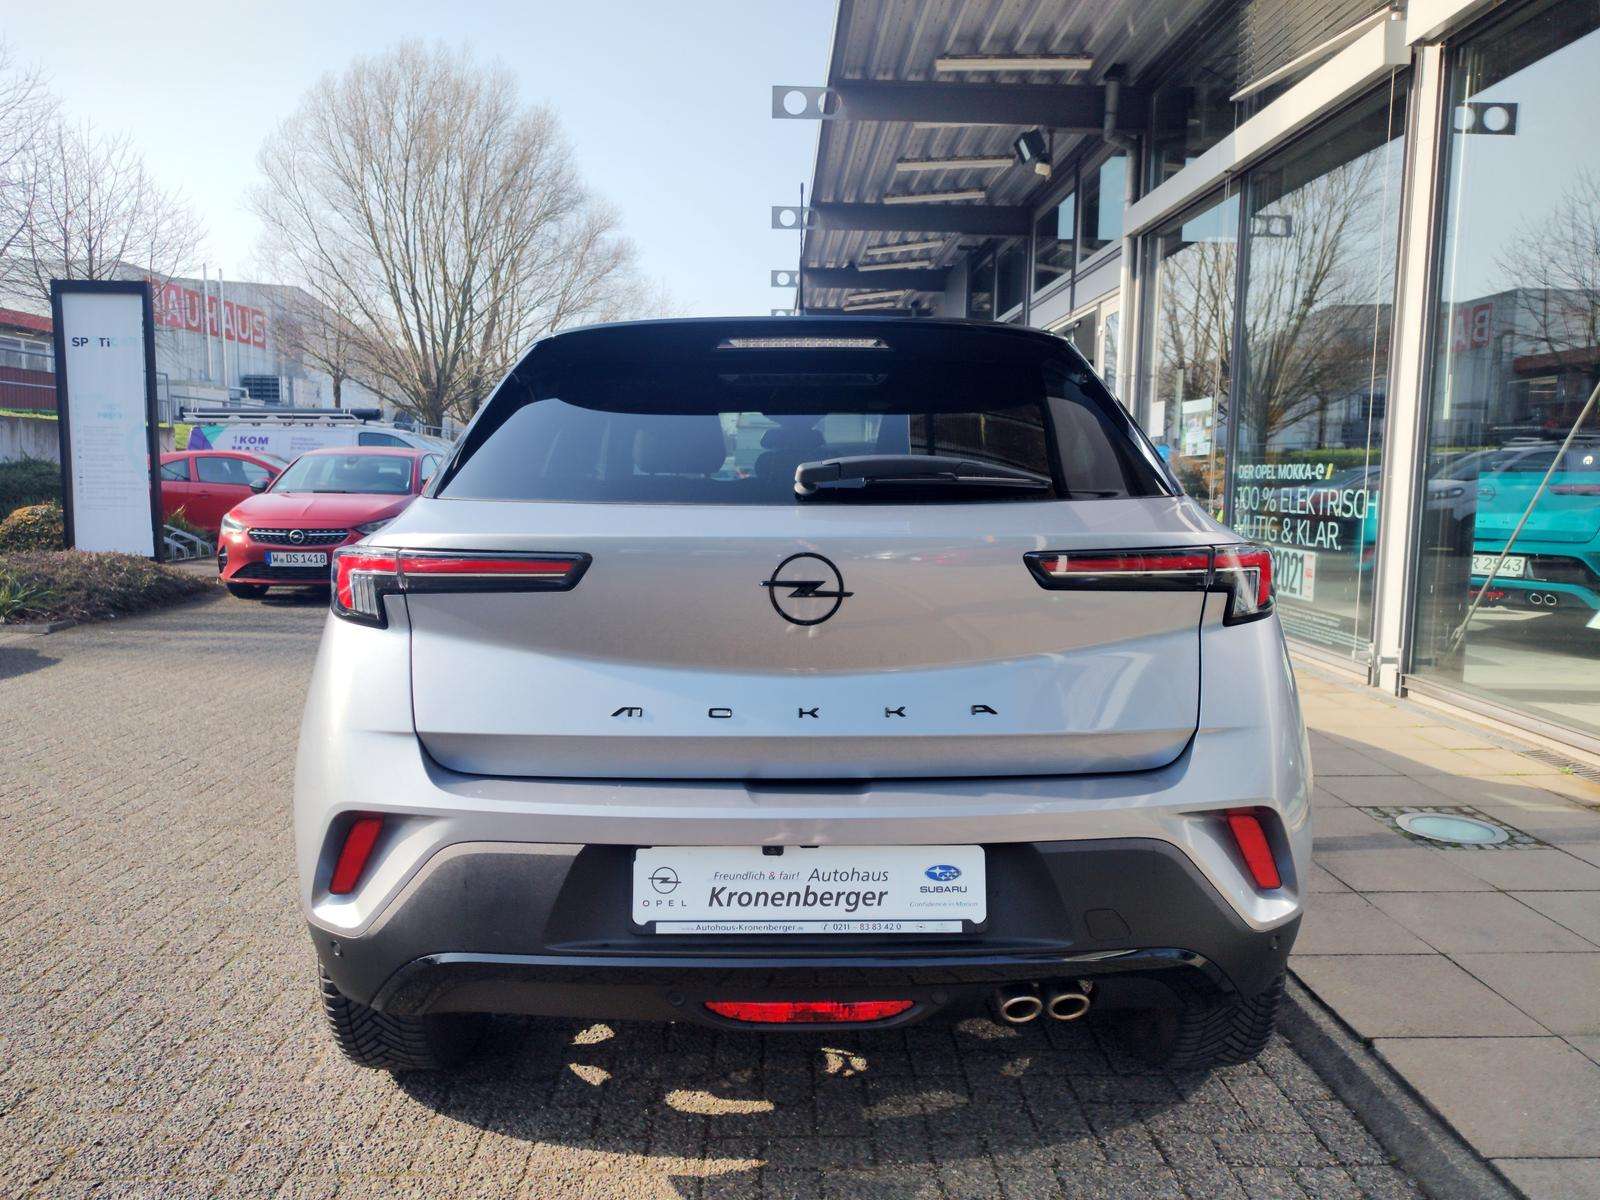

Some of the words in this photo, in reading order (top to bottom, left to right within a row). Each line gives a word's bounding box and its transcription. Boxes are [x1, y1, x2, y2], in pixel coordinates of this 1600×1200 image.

[1238, 465, 1255, 479] DER
[1256, 464, 1275, 479] OPEL
[1237, 486, 1259, 510] 100
[1262, 487, 1277, 512] %
[1280, 487, 1379, 519] ELEKTRISCH
[1235, 514, 1277, 541] MUTIG
[1281, 518, 1293, 544] &
[1297, 520, 1341, 550] KLAR.
[611, 705, 998, 718] MOKKA
[713, 871, 765, 880] Freundlich
[768, 871, 776, 880] &
[779, 871, 800, 880] fair!
[808, 868, 889, 882] Autohaus
[708, 885, 889, 912] Kronenberger
[859, 923, 869, 931] 83
[872, 923, 882, 931] 83
[884, 923, 894, 931] 42
[896, 923, 902, 931] 0
